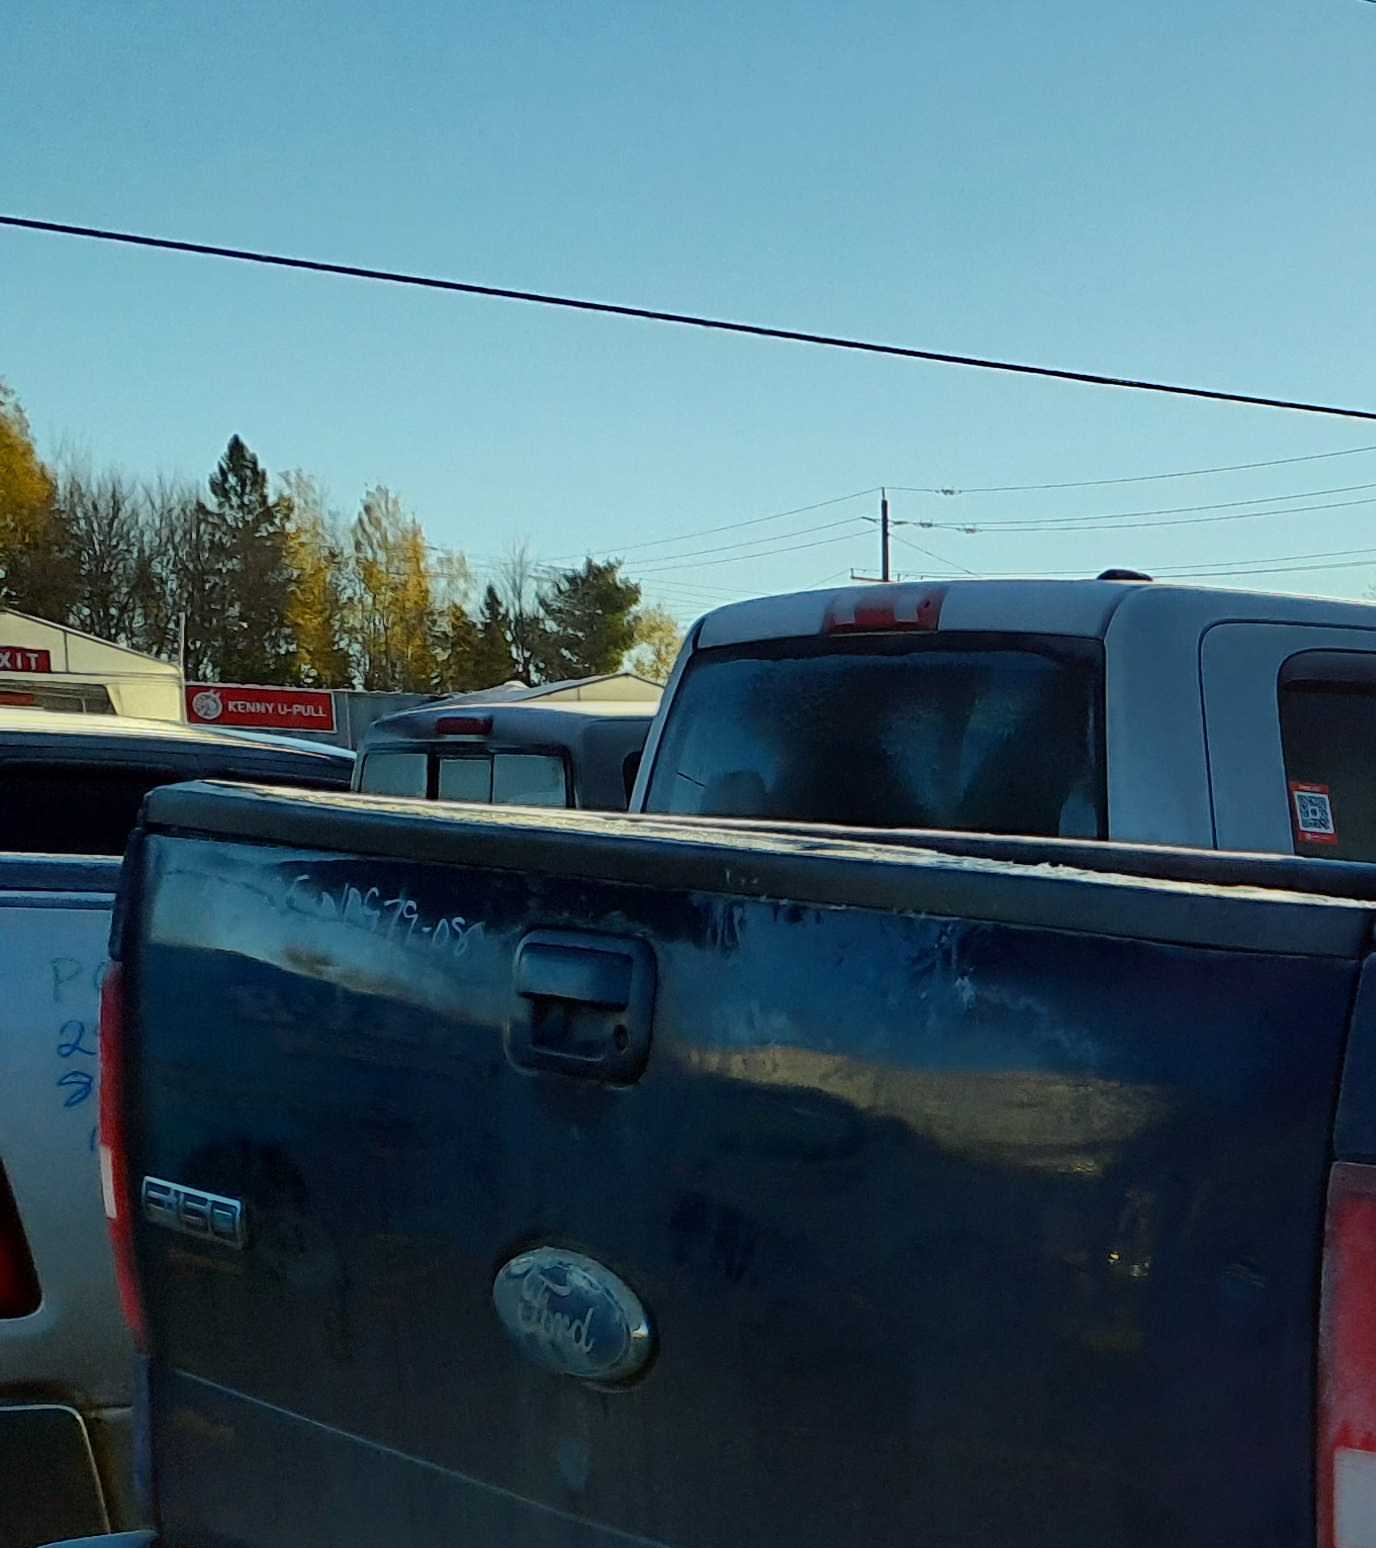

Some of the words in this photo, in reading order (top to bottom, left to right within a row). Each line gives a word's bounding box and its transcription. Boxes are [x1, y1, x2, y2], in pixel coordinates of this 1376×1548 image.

[0, 651, 39, 670] XIT
[228, 701, 275, 714] KENNY
[278, 704, 327, 717] U-PULL
